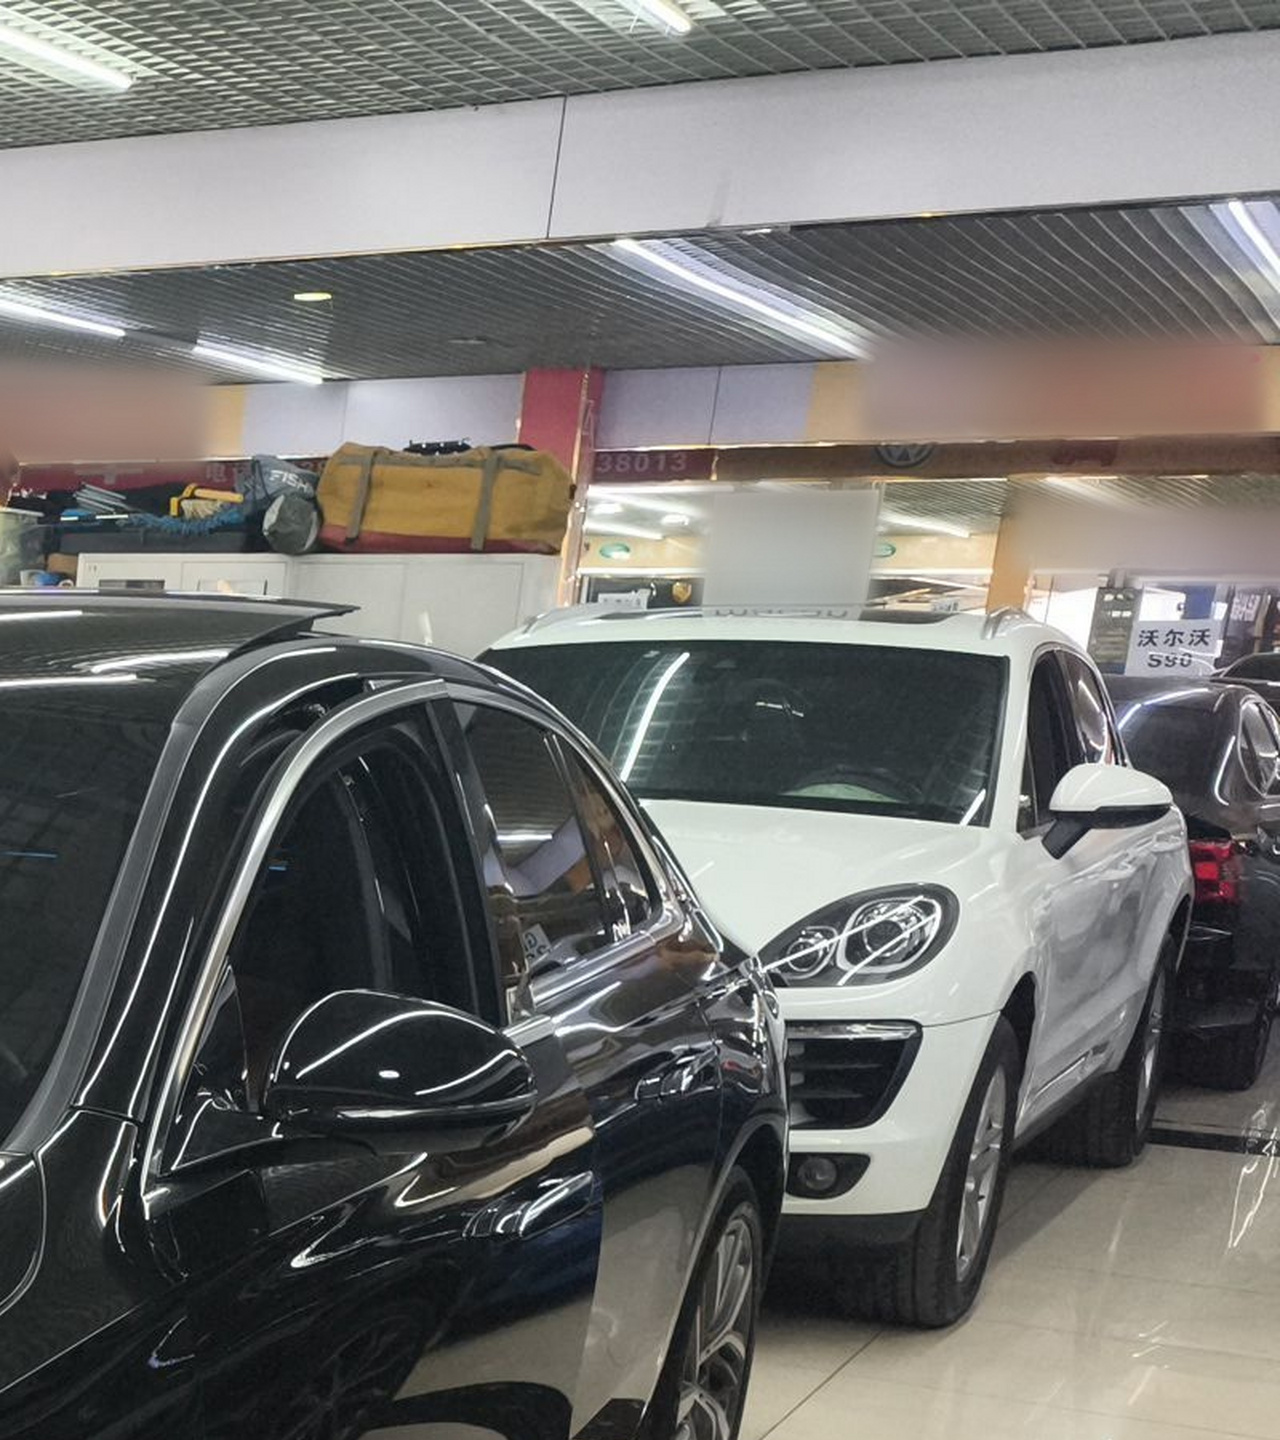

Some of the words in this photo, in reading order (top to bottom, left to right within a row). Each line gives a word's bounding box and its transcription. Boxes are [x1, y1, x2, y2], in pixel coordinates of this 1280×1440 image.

[1138, 628, 1211, 647] 沃尔沃
[1147, 653, 1193, 668] S90
